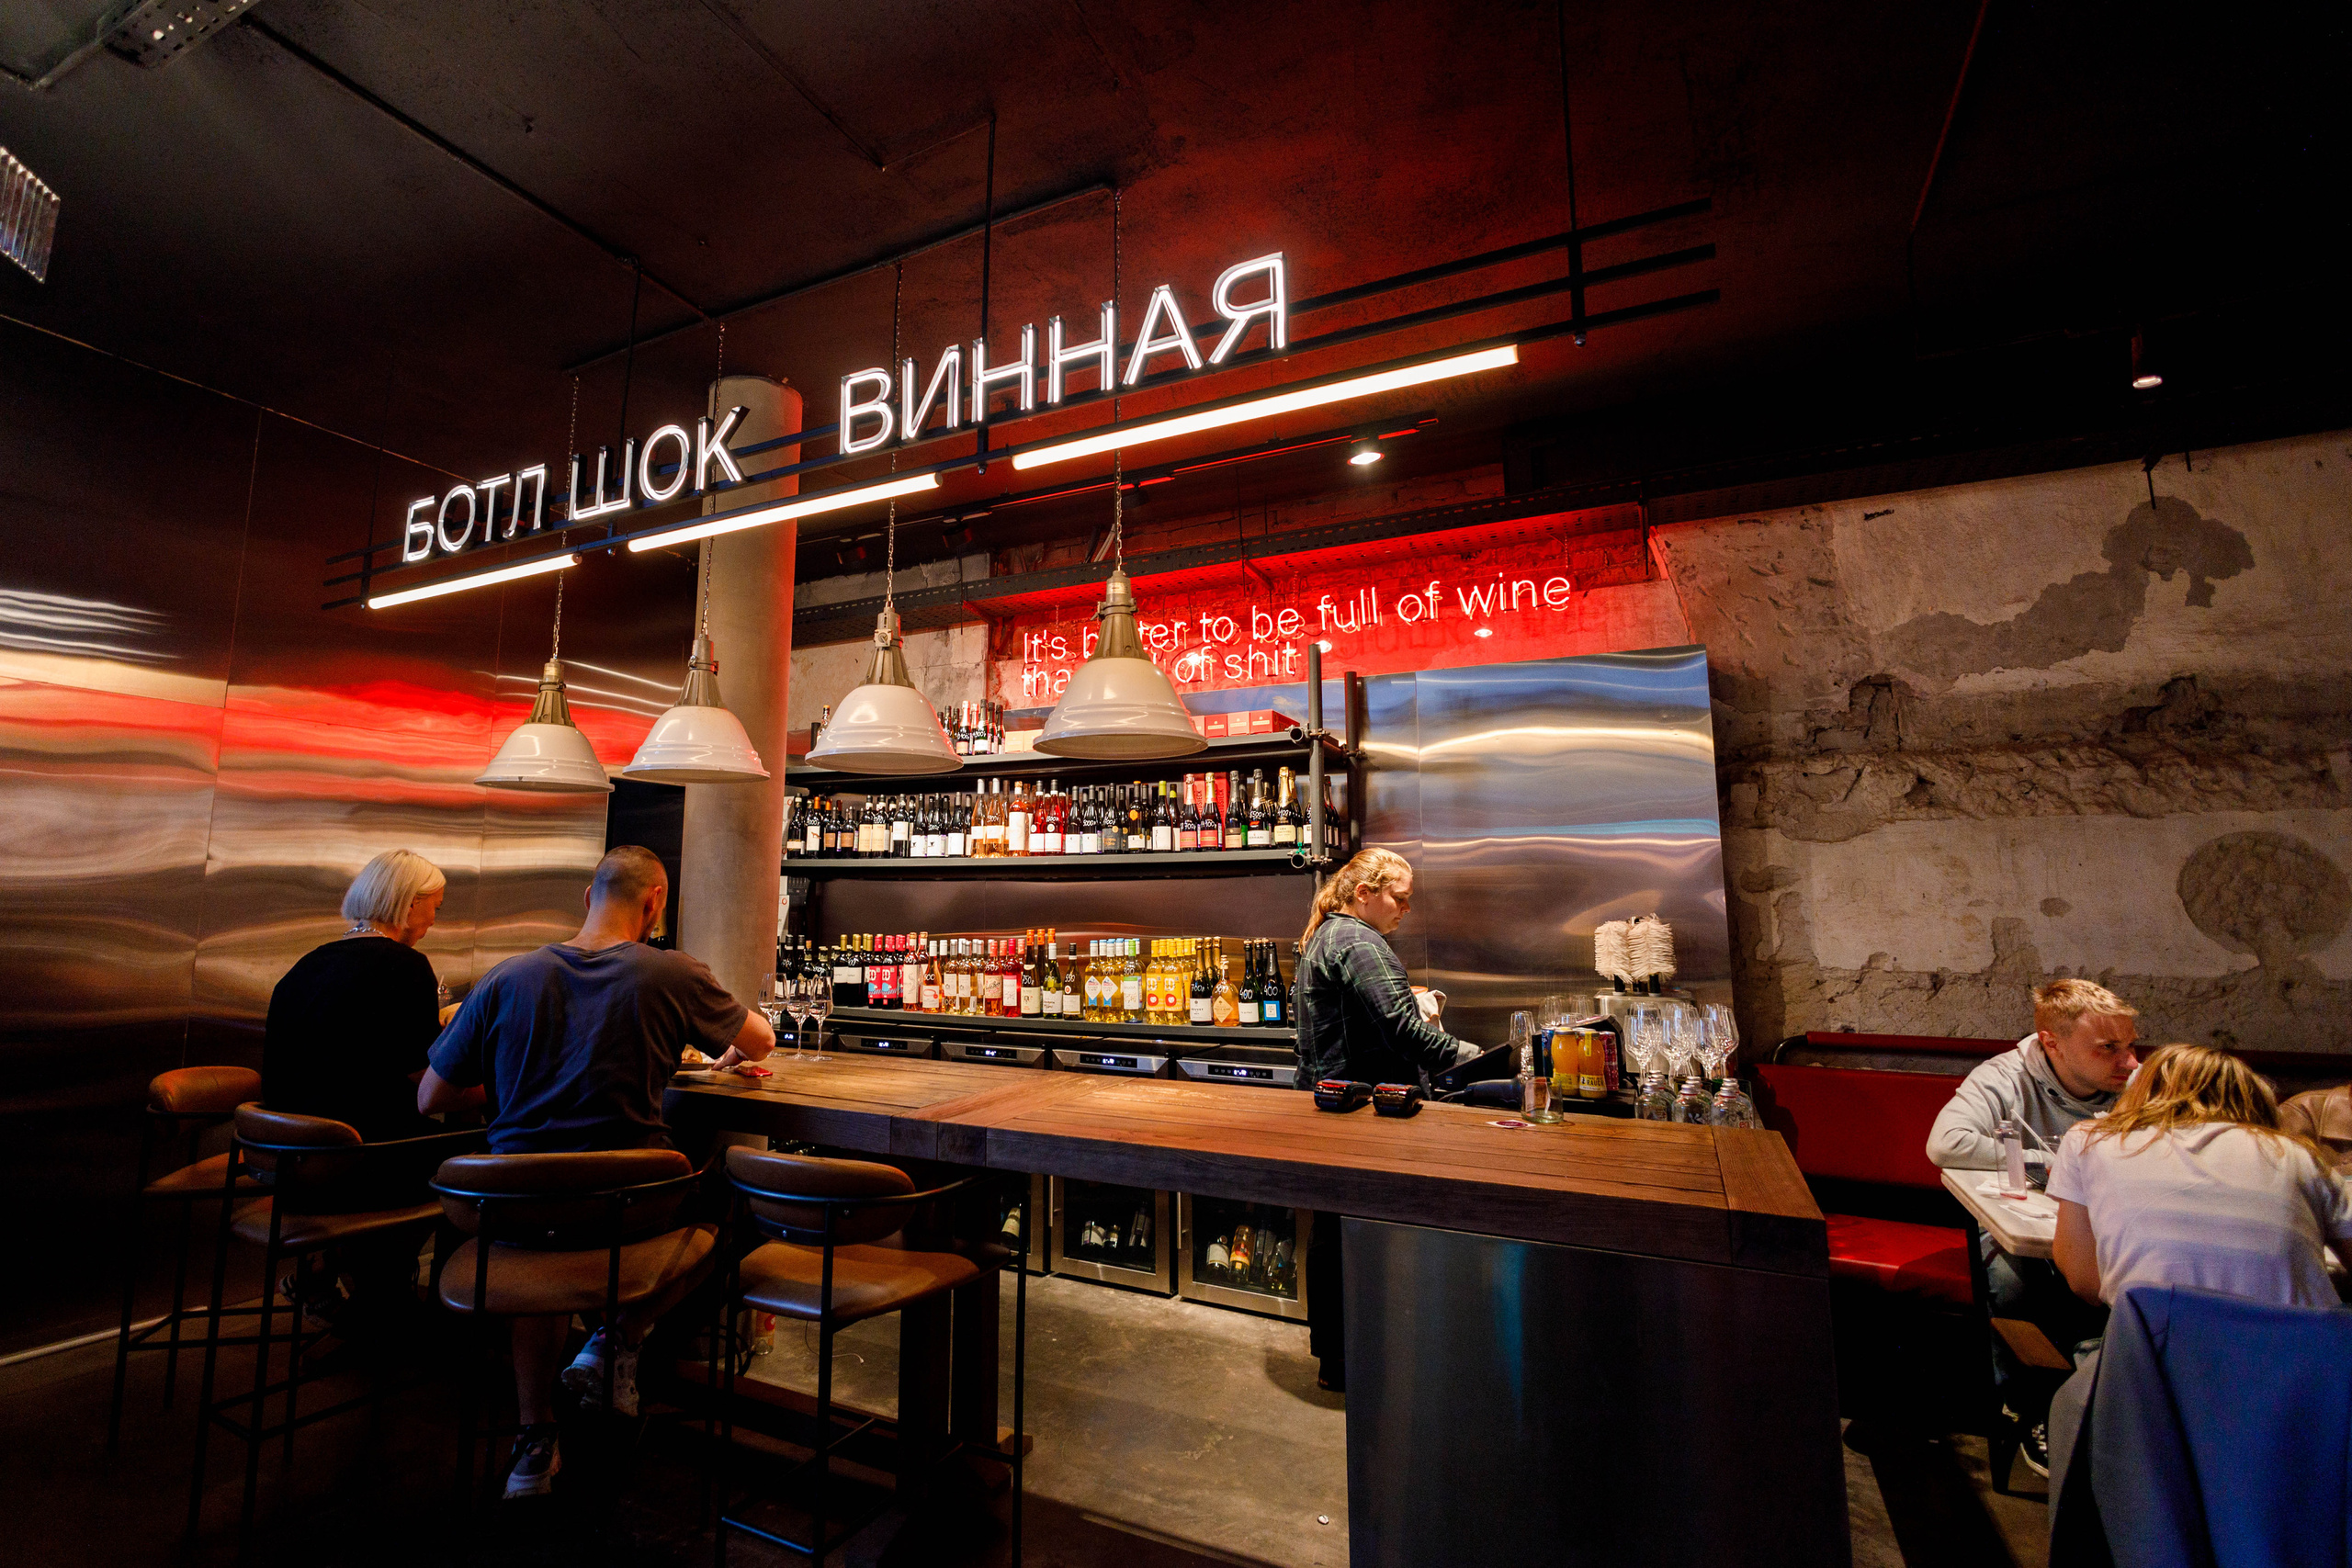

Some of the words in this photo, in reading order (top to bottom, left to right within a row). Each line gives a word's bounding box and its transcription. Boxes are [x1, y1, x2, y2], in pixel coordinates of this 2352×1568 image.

[402, 463, 549, 563] БОТЛ
[568, 405, 749, 521] ШОК
[840, 251, 1287, 456] ВИННАЯ
[1024, 629, 1067, 664] It's
[1083, 620, 1187, 660] bter
[1200, 612, 1234, 643] to
[1252, 605, 1300, 641] be
[1317, 586, 1378, 631] full
[1397, 581, 1441, 623] of
[1457, 572, 1570, 615] wine
[1022, 665, 1071, 696] tha
[1175, 646, 1212, 682] of
[1225, 640, 1297, 680] shit
